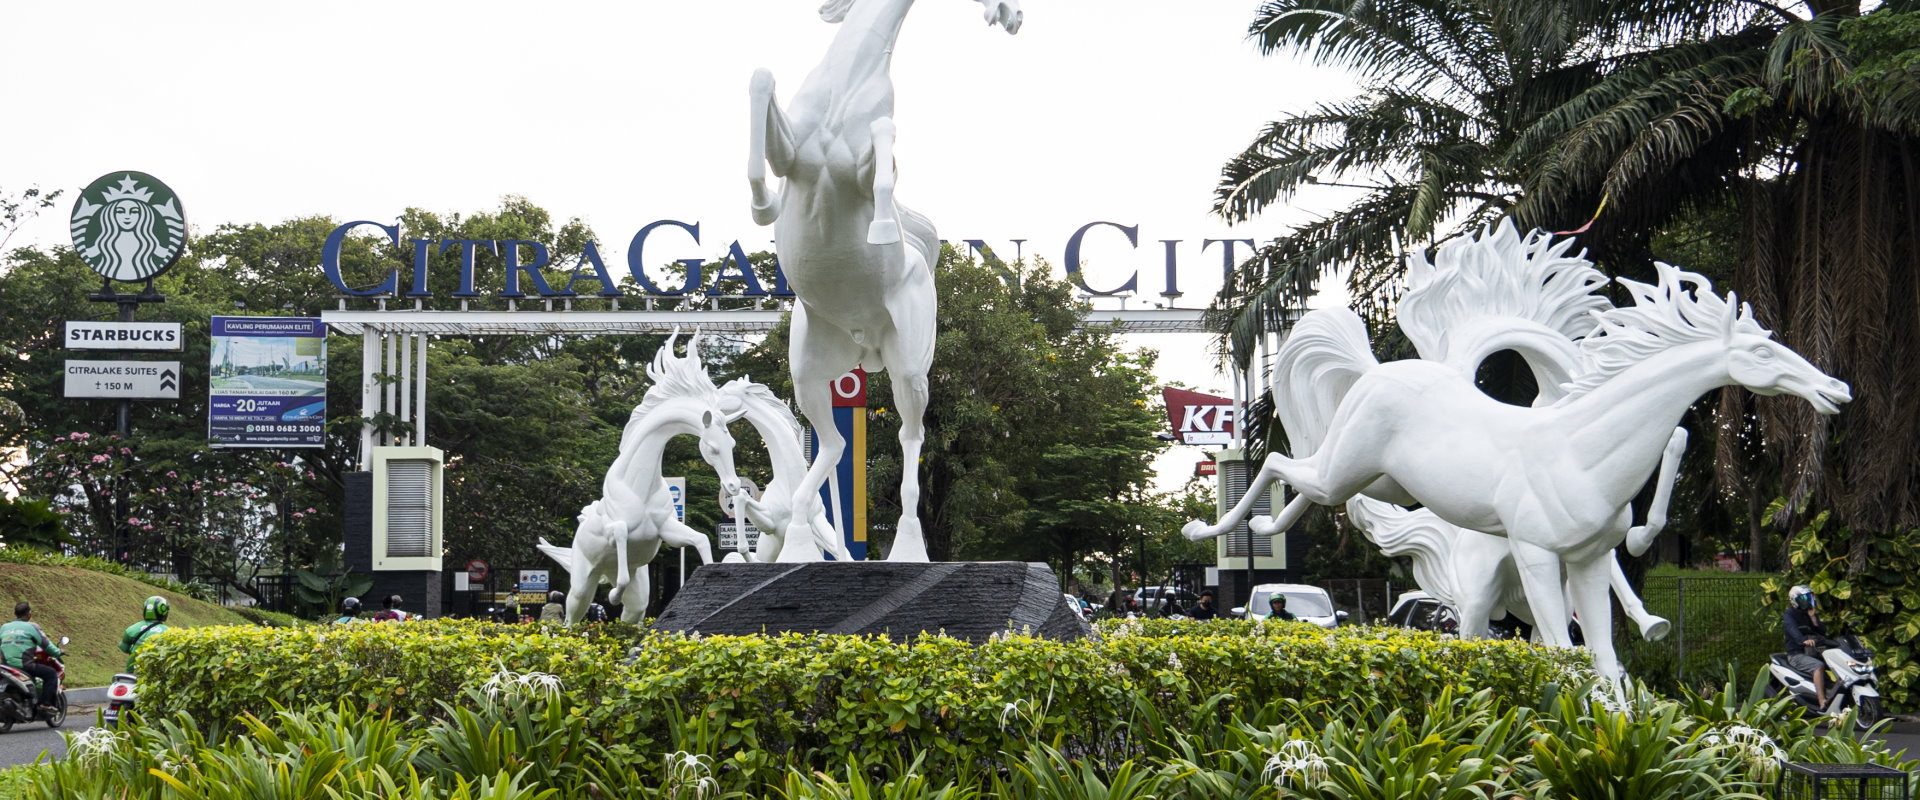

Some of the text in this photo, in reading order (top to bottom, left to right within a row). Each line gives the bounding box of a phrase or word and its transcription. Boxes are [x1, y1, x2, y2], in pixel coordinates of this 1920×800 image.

[321, 219, 1262, 298] CITRAGAN CIT
[70, 328, 175, 342] STARBUCKS
[68, 366, 158, 376] CITRALAKE SUITES
[104, 382, 121, 390] 150
[123, 382, 133, 390] M
